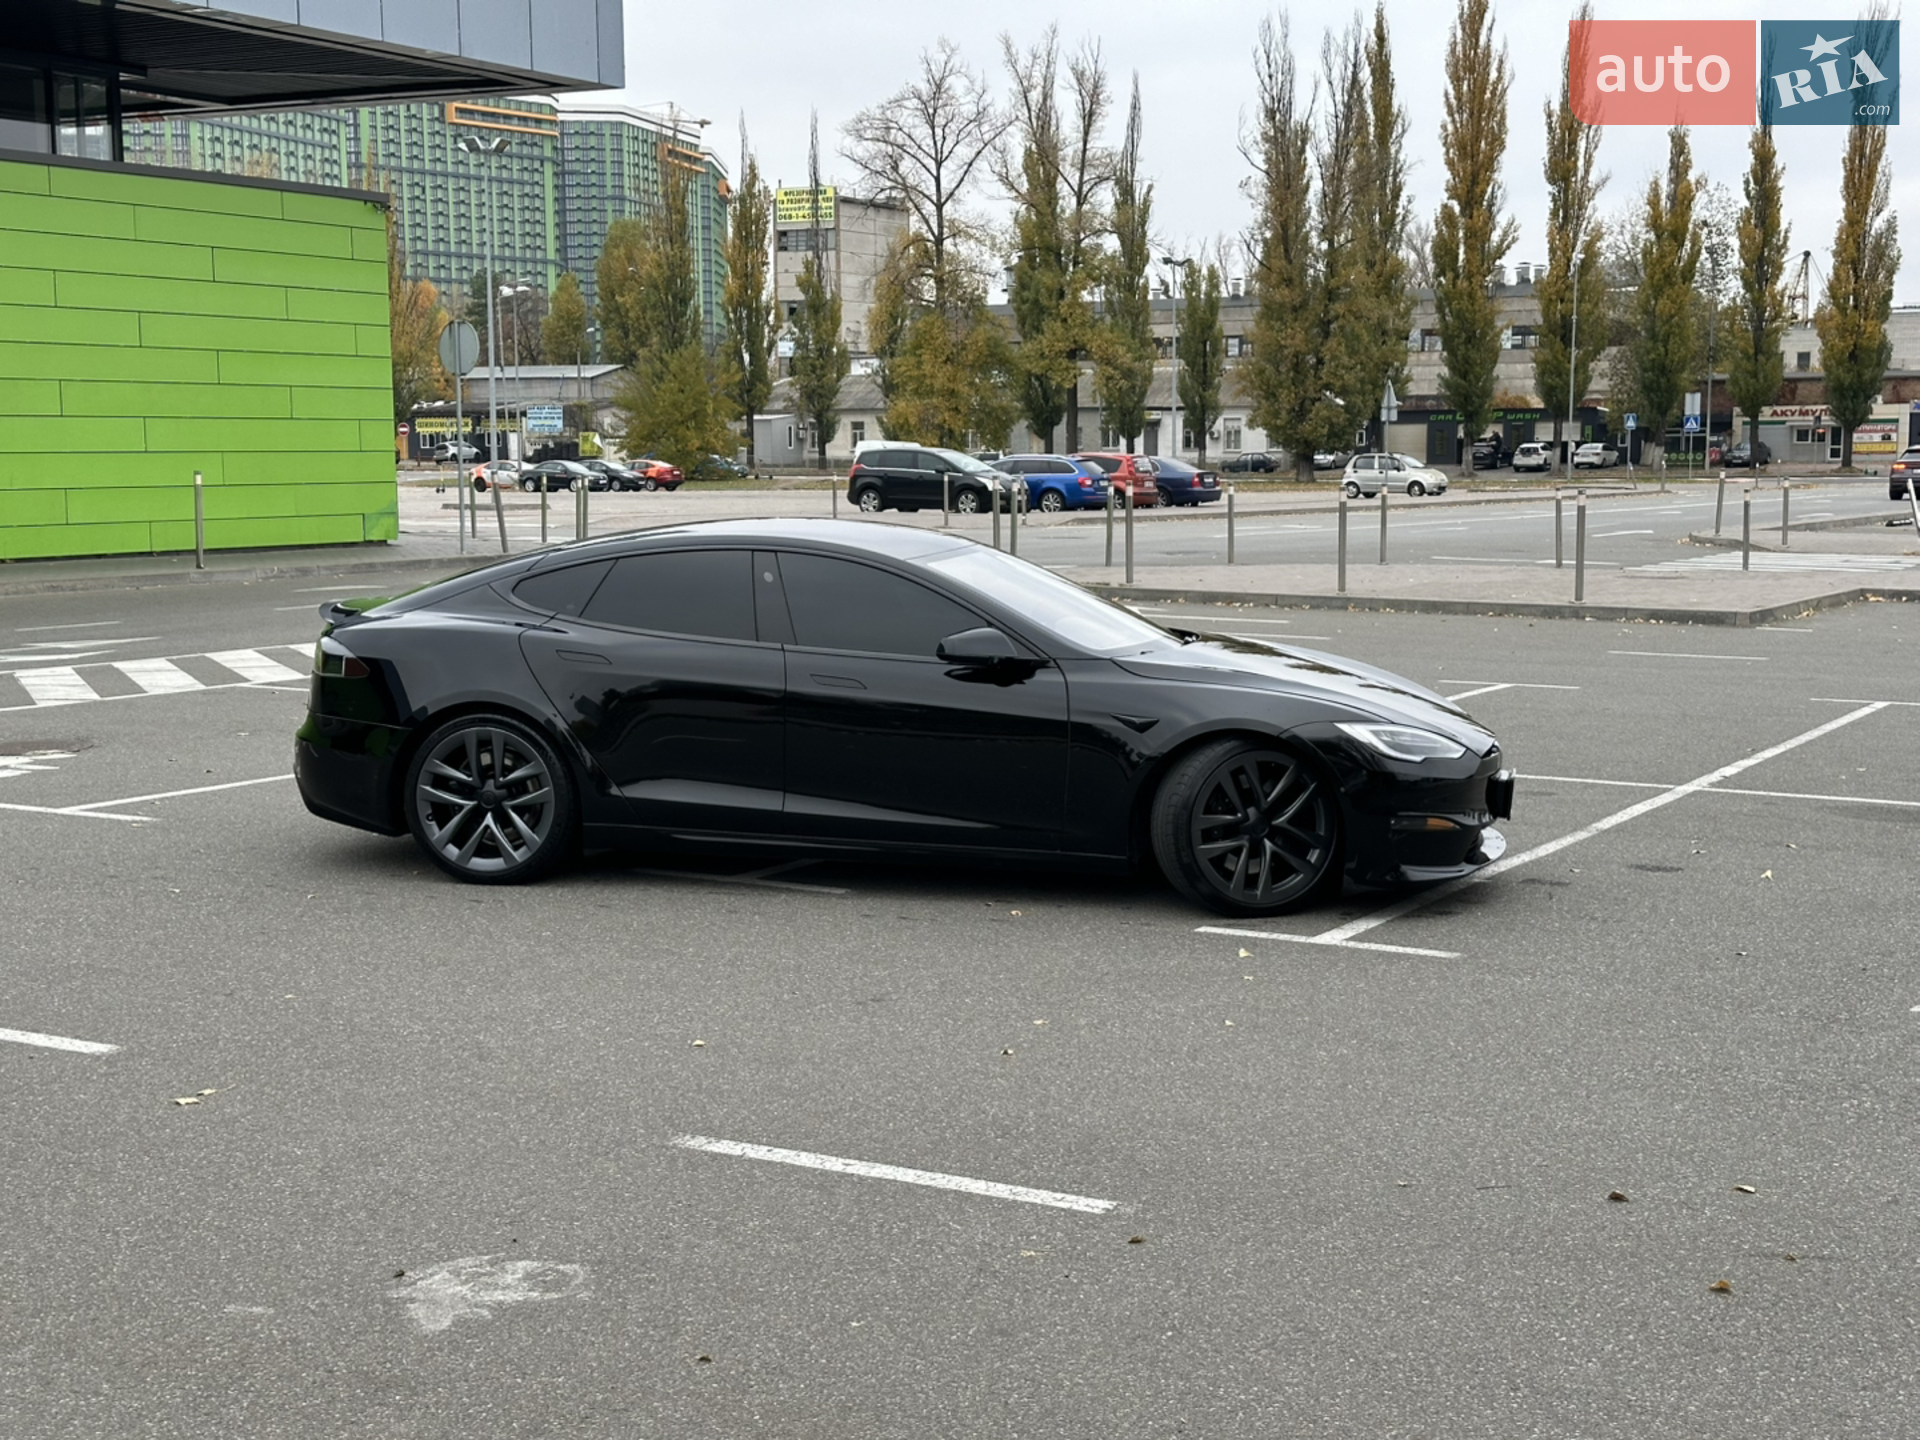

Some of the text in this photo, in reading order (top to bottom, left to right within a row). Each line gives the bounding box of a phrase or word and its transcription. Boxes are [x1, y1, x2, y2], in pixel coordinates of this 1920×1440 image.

[1429, 413, 1453, 421] CAR
[1506, 412, 1541, 420] WASH
[416, 421, 470, 429] ШИНОМОНТЖ
